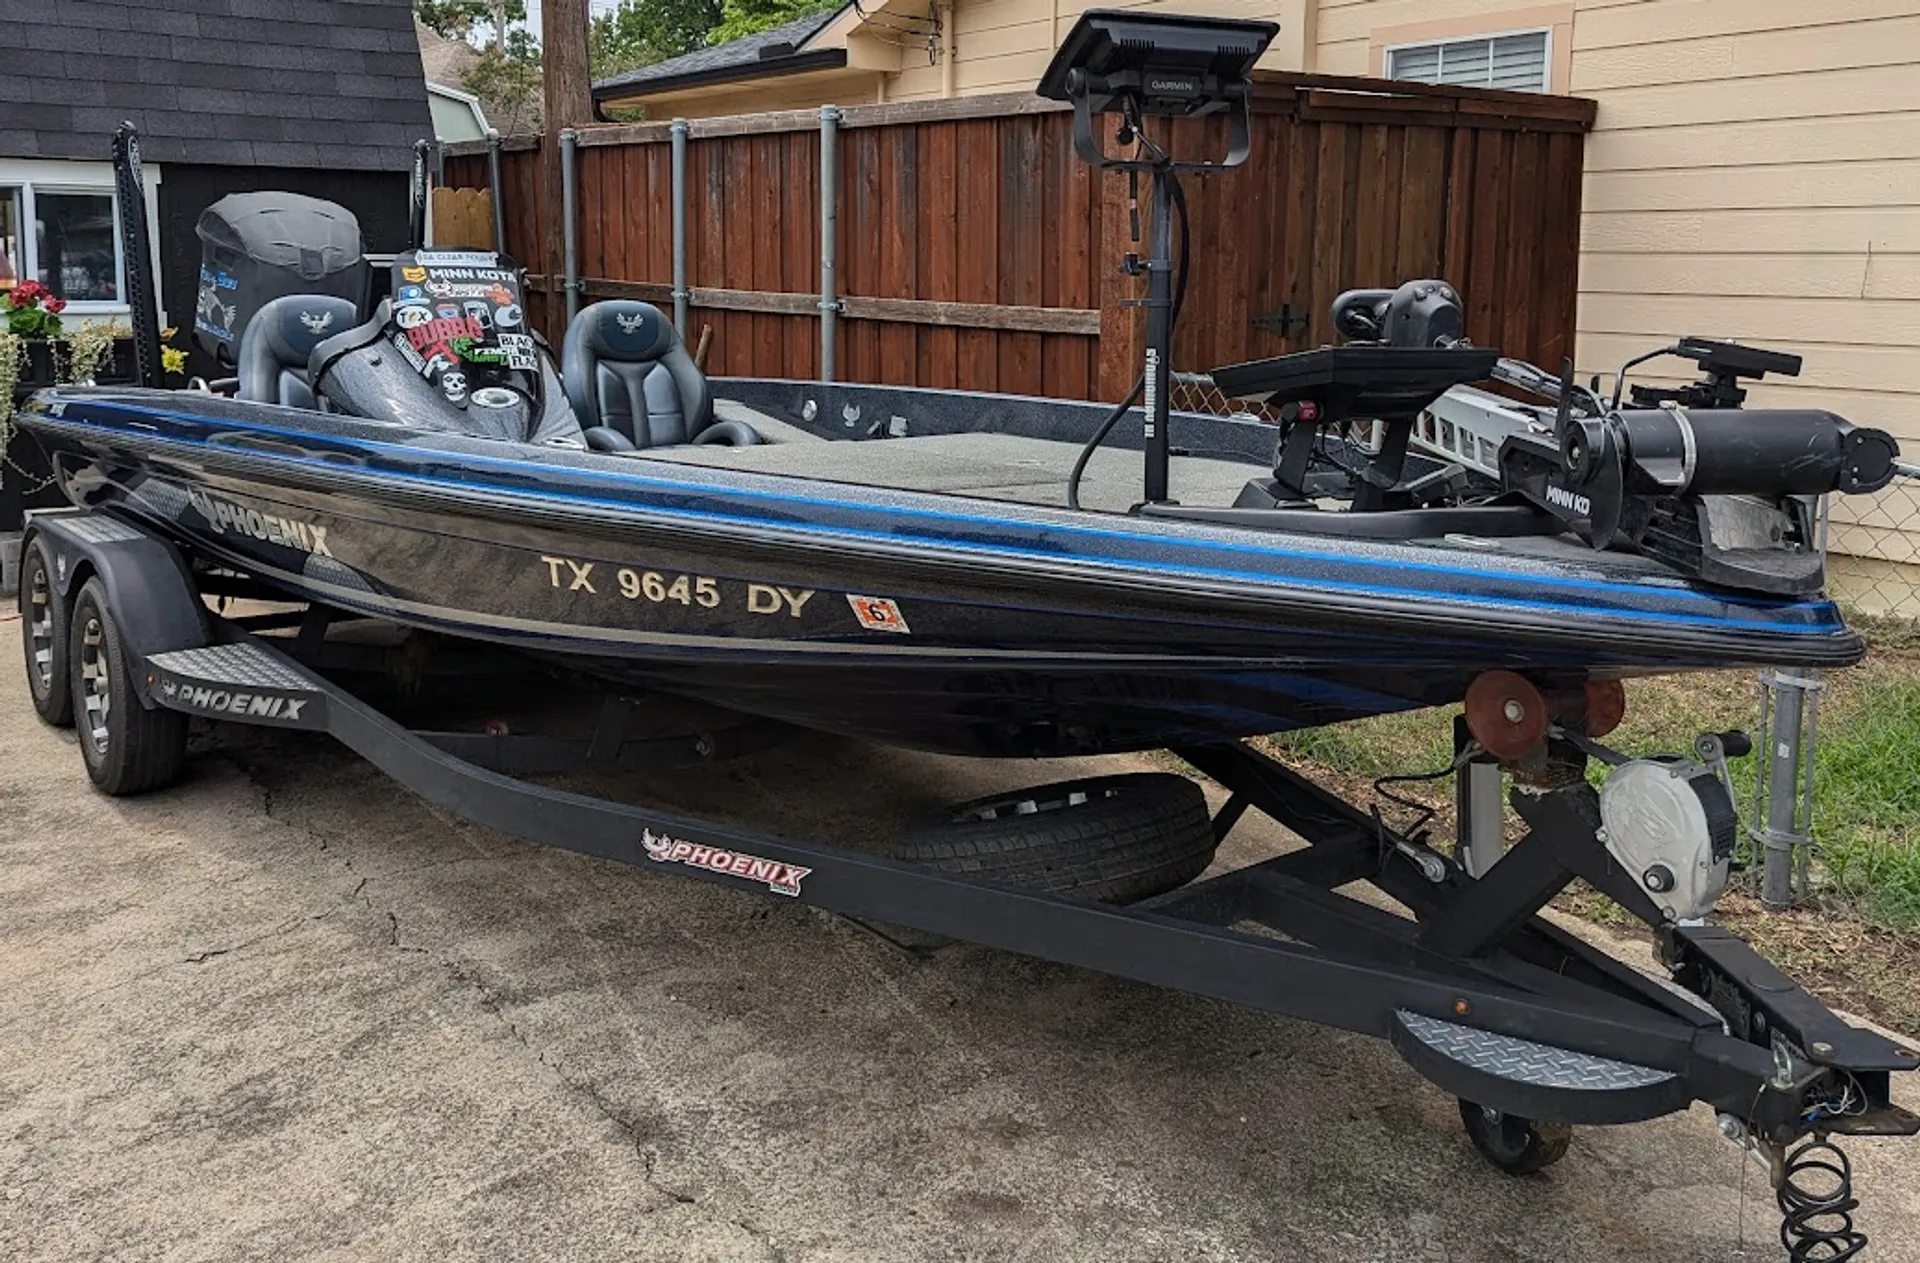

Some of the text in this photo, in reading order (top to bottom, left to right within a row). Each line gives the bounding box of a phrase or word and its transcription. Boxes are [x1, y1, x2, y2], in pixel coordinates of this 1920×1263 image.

[1151, 80, 1193, 91] GARMIN
[429, 269, 475, 279] MINN
[476, 269, 518, 282] KOTA
[500, 335, 533, 347] BLAC
[1546, 485, 1574, 509] MINN
[214, 501, 333, 558] PHOENIX
[541, 555, 815, 617] TX 9645 DY
[179, 685, 308, 720] PHOENIX
[671, 841, 811, 886] PHOENIX
